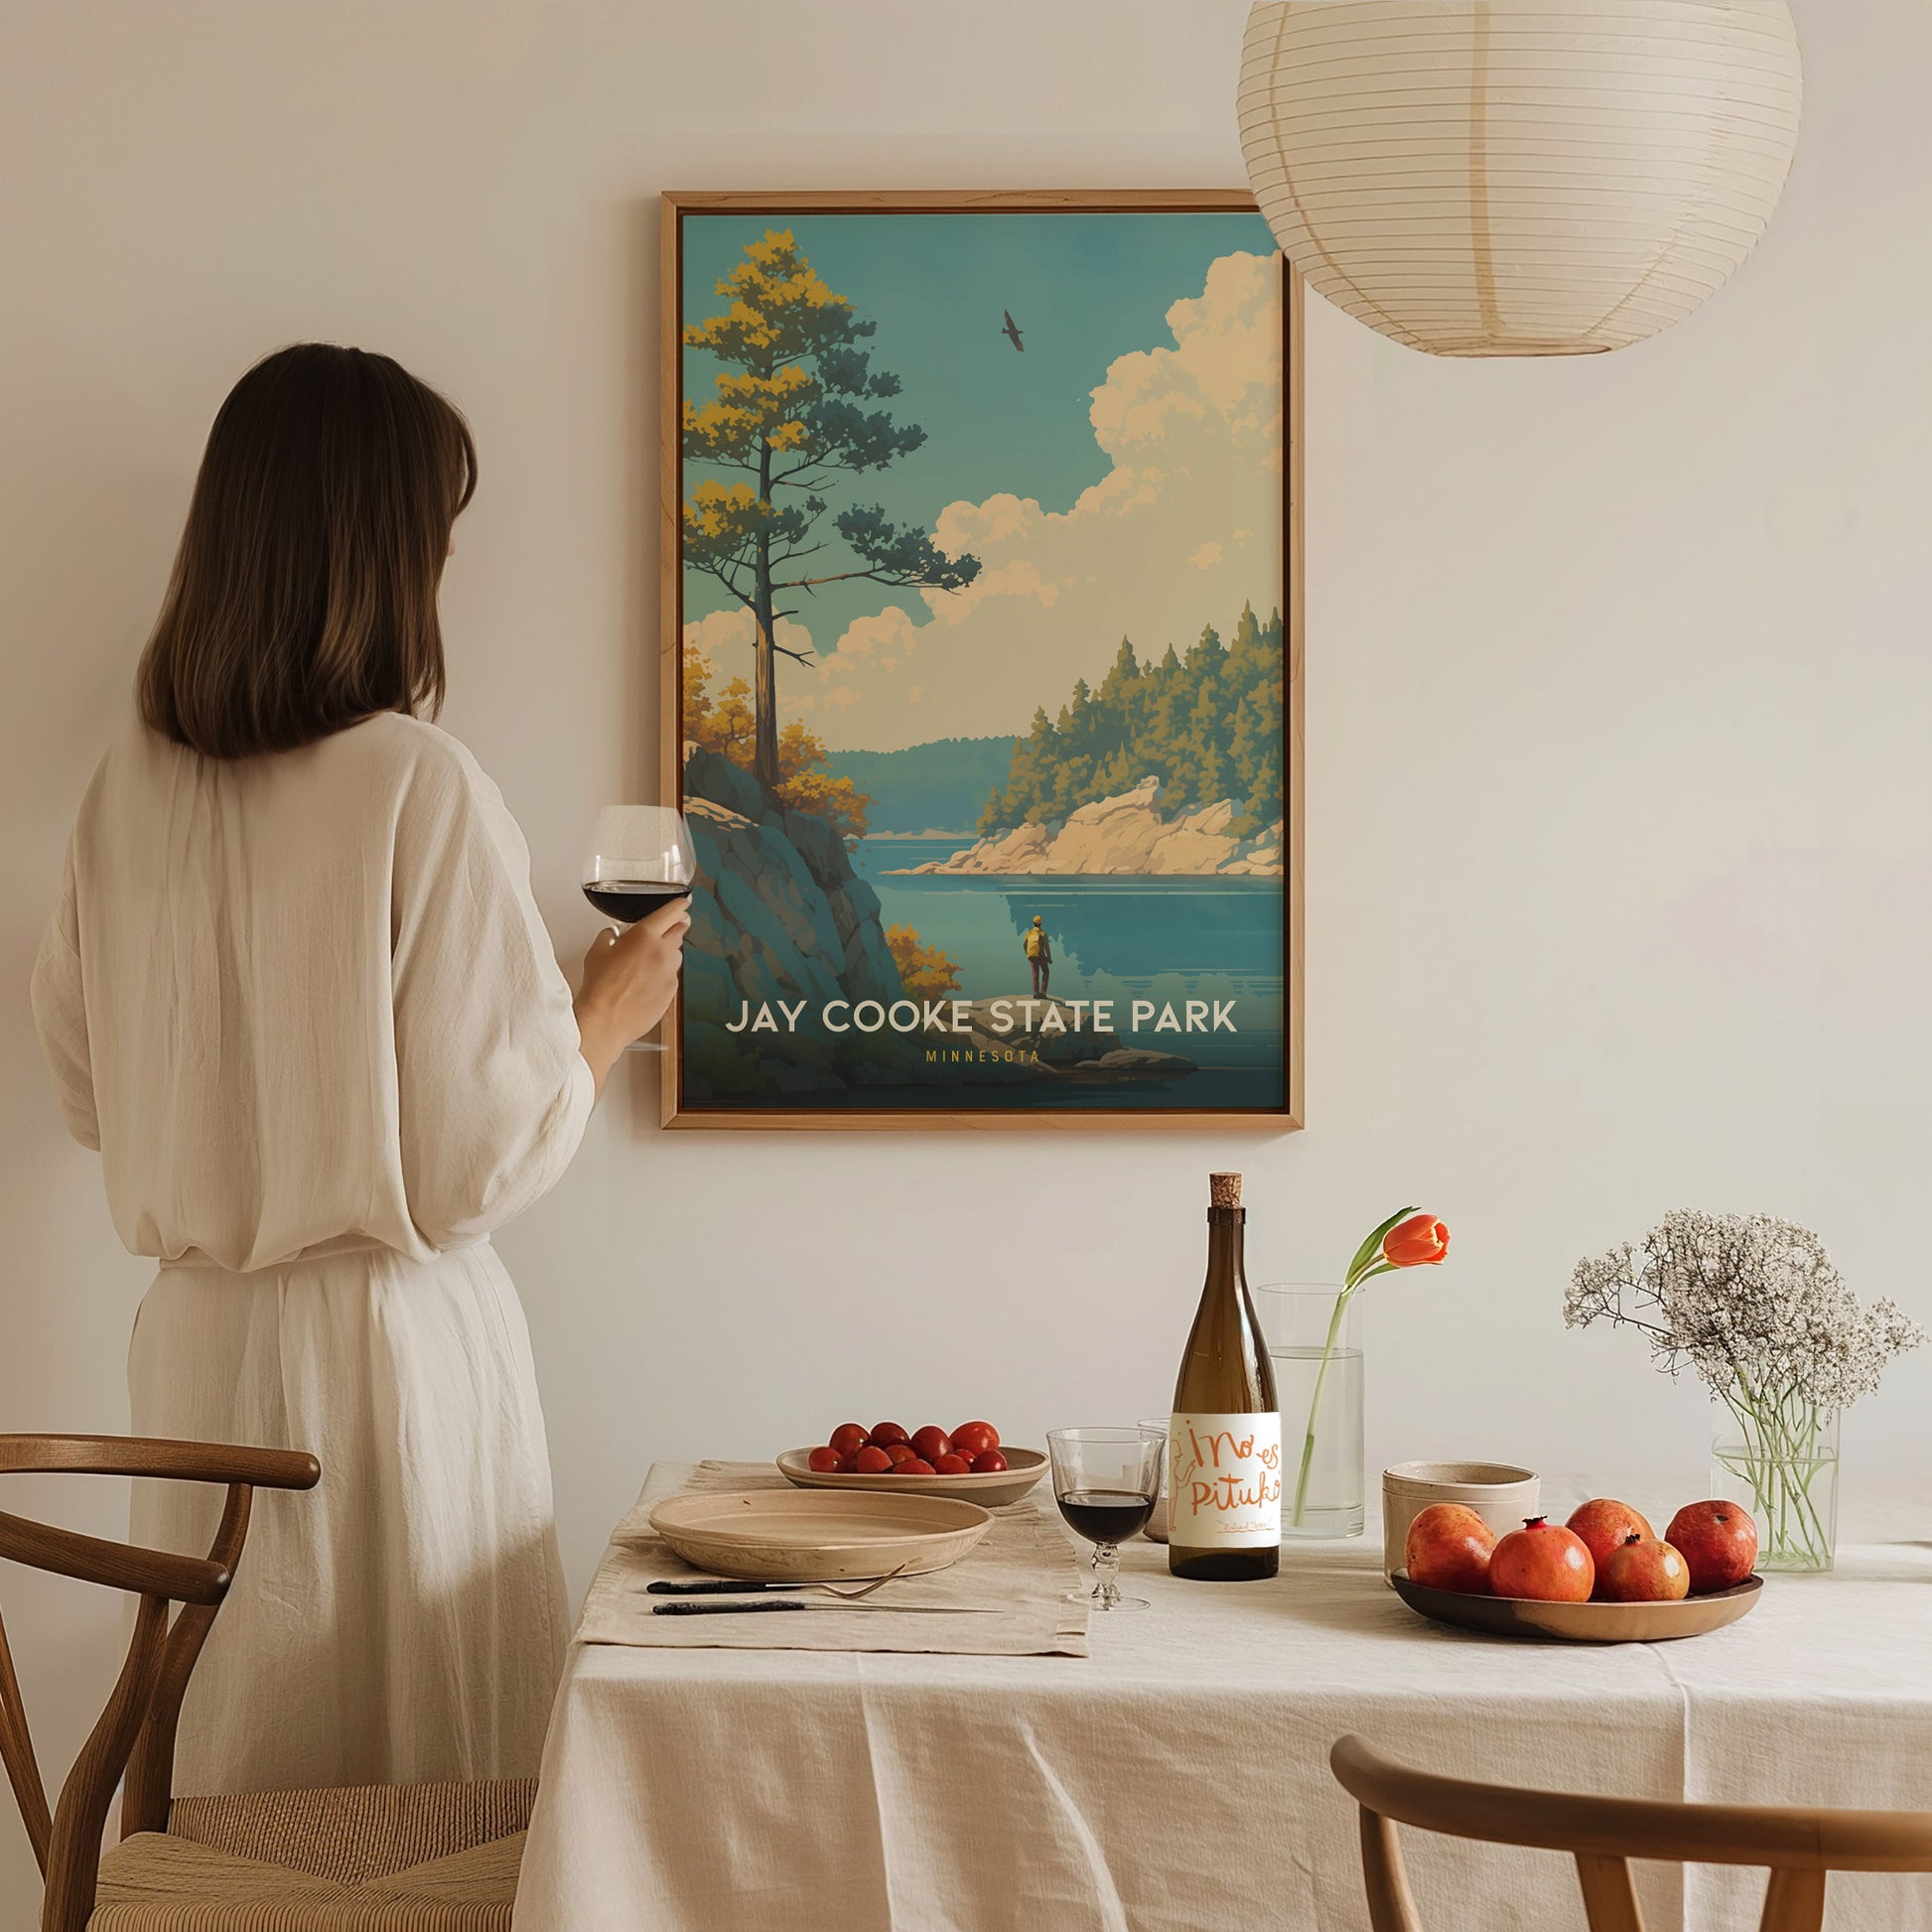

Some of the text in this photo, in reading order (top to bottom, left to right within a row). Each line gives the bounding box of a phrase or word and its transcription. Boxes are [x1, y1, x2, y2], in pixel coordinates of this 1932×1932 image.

[725, 1000, 1238, 1033] JAY COOKE STATE PARK
[925, 1049, 1039, 1062] MINNESOTA
[1256, 1444, 1279, 1469] es
